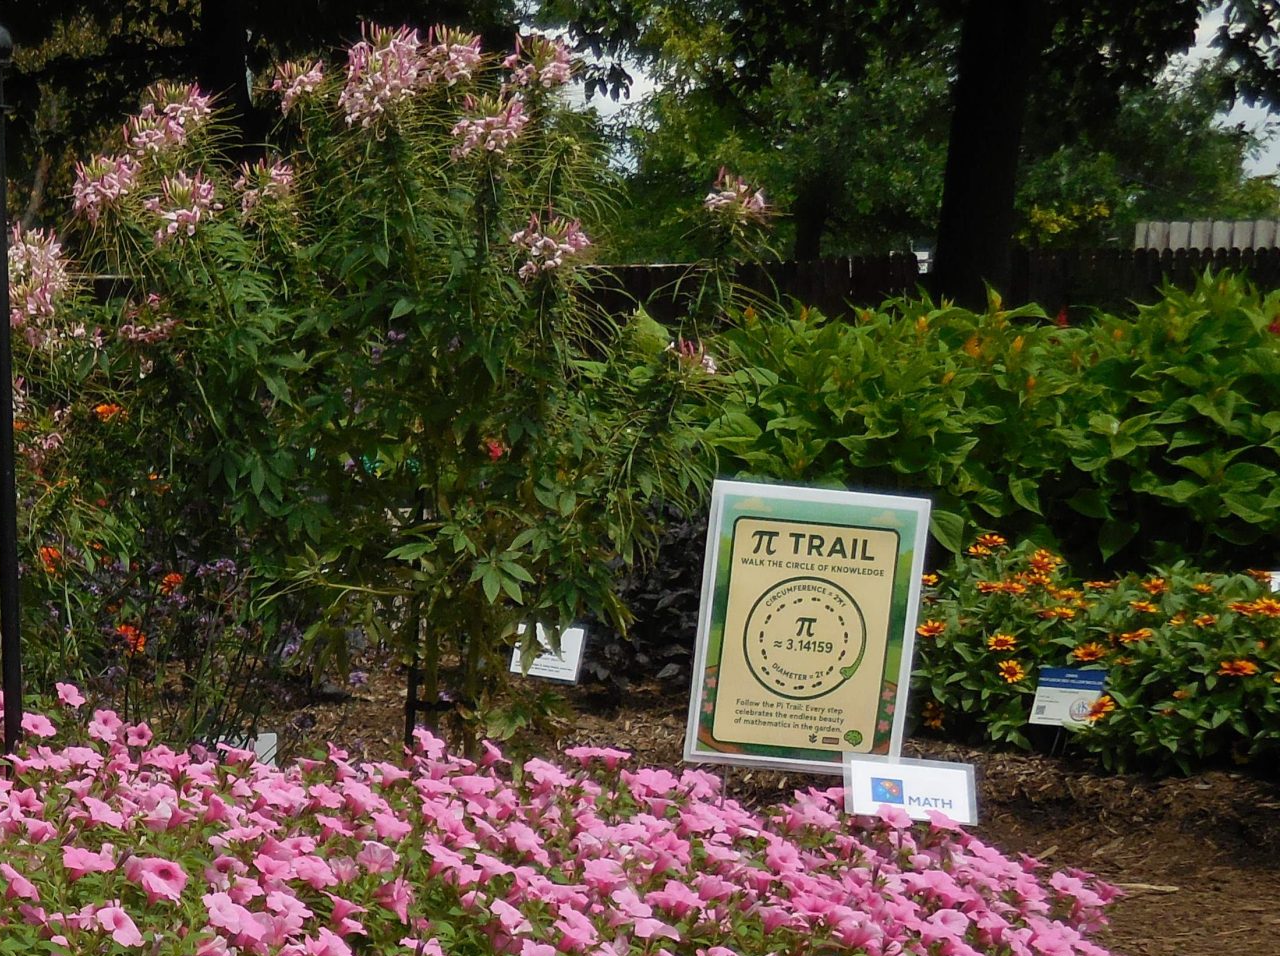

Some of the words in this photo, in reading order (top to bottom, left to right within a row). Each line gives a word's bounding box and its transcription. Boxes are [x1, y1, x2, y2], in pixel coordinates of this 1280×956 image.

[789, 532, 875, 562] TRAIL
[741, 557, 765, 567] WALK
[767, 559, 783, 568] THE
[785, 561, 815, 571] CIRCLE
[817, 564, 829, 572] OF
[831, 565, 885, 577] KNOWLEDGE
[766, 584, 826, 607] CIRCUMFERENCE
[786, 638, 833, 653] 3.14159
[772, 662, 807, 681] DIAMETER
[735, 708, 773, 718] celebrates
[775, 711, 787, 719] the
[789, 713, 817, 722] endless
[819, 715, 845, 725] beauty
[736, 698, 759, 707] Follow
[762, 701, 775, 709] the
[805, 704, 825, 715] Every
[827, 706, 843, 717] step
[743, 718, 791, 729] mathematics
[801, 722, 813, 731] the
[908, 796, 953, 809] MATH
